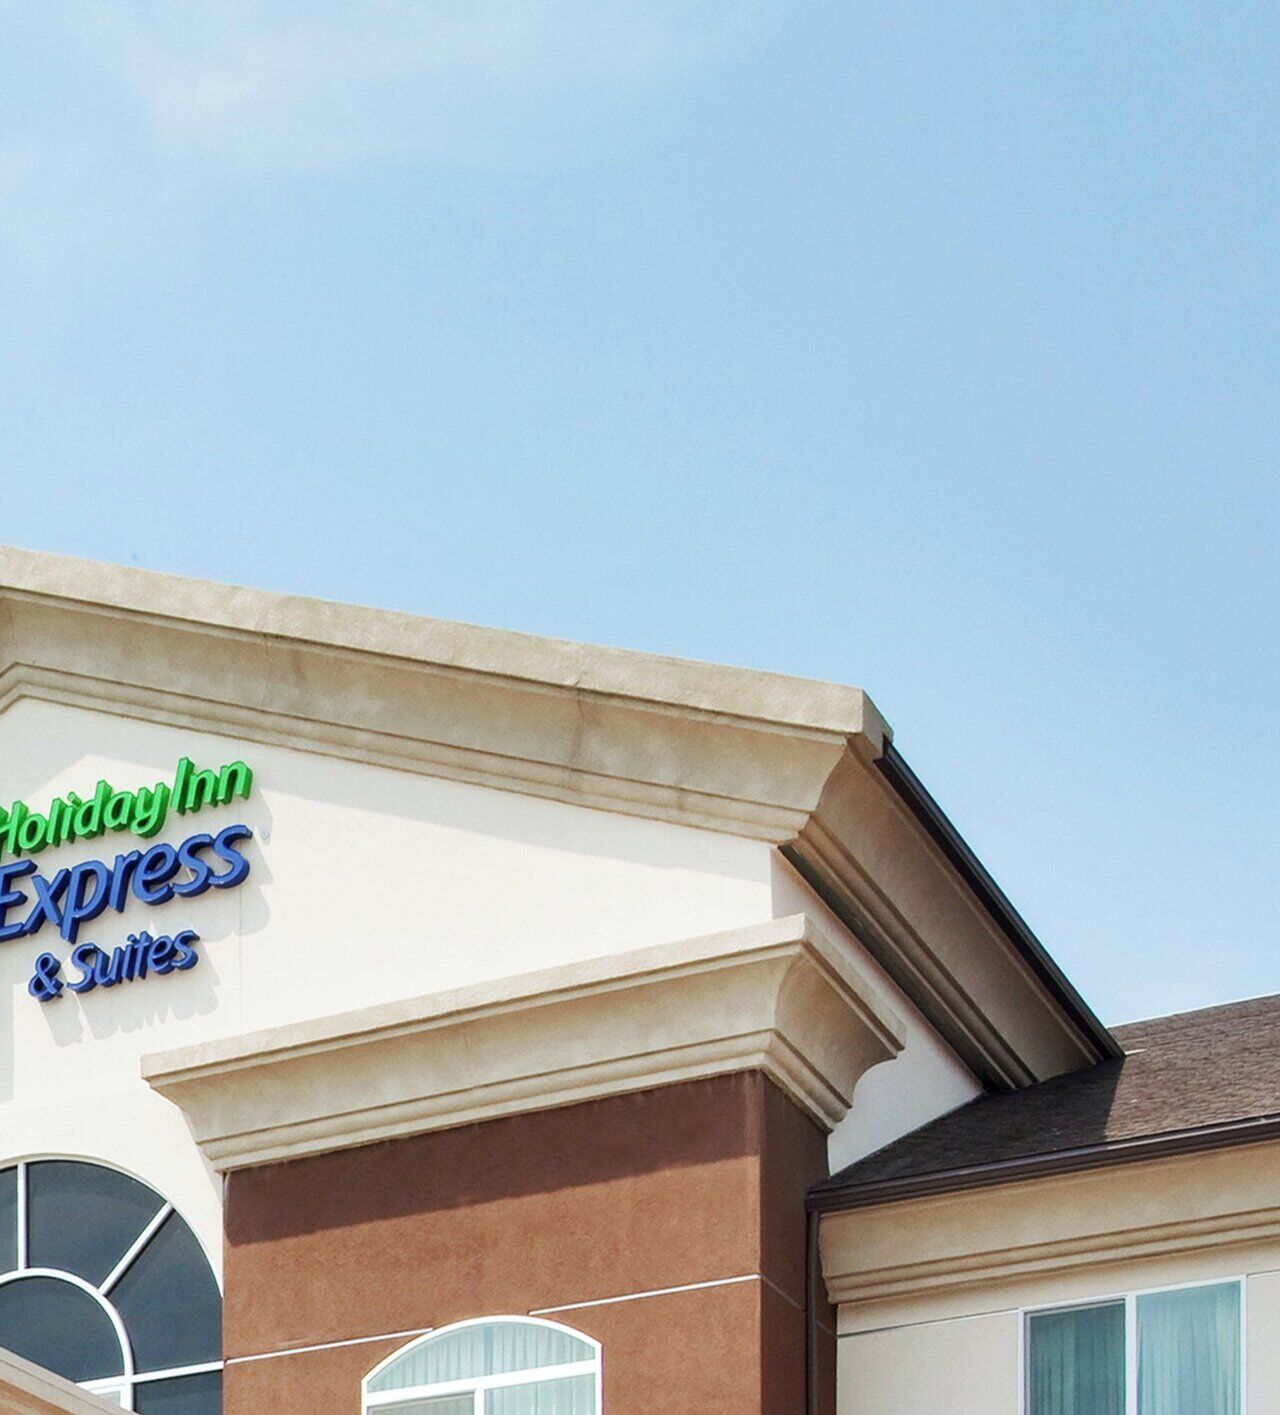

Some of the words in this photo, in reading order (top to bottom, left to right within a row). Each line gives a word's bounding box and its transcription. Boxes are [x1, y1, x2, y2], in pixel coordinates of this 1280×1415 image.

[170, 757, 253, 815] Inn
[29, 951, 64, 1002] &
[66, 930, 200, 993] Suites
